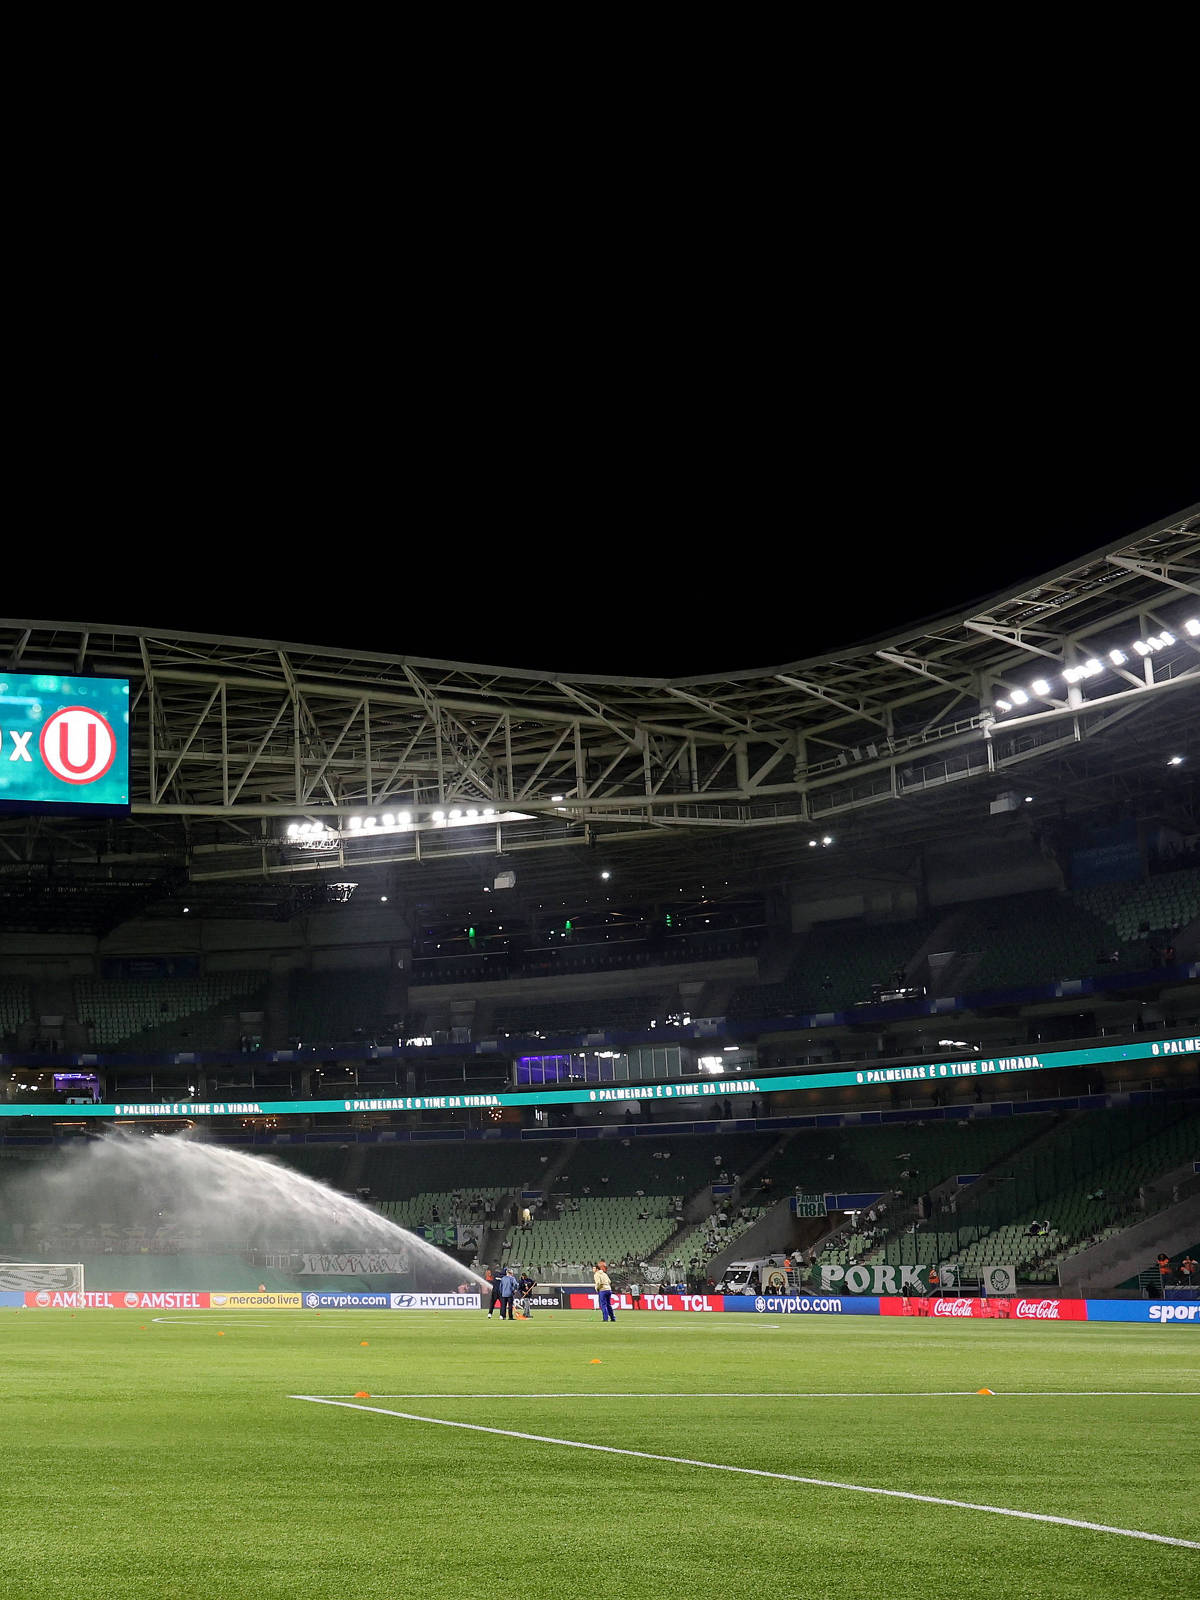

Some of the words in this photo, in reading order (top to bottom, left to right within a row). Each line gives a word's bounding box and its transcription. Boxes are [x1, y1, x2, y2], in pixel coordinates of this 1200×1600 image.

[59, 722, 97, 774] U
[1151, 1043, 1160, 1056] O
[856, 1072, 864, 1084] O
[866, 1066, 926, 1083] PALMEIRAS
[929, 1064, 936, 1077] É
[939, 1064, 947, 1077] O
[950, 1062, 978, 1076] TIME
[980, 1060, 996, 1073] DA
[589, 1090, 597, 1101] O
[599, 1087, 654, 1101] PALMEIRAS
[655, 1085, 663, 1098] É
[665, 1085, 673, 1097] O
[675, 1084, 700, 1096] TIME
[702, 1083, 716, 1095] DA
[114, 1104, 122, 1115] O
[123, 1103, 171, 1115] PALMEIRAS
[172, 1103, 179, 1114] É
[181, 1104, 189, 1115] O
[189, 1103, 211, 1114] TIME
[213, 1103, 226, 1114] DA
[344, 1100, 352, 1111] O
[353, 1098, 404, 1111] PALMEIRAS
[406, 1097, 413, 1109] É
[414, 1098, 422, 1109] O
[423, 1097, 446, 1108] TIME
[448, 1096, 461, 1107] DA
[52, 1292, 112, 1307] AMSTEL
[141, 1293, 200, 1308] AMSTEL
[228, 1294, 278, 1306] mercado
[279, 1294, 300, 1306] livre
[320, 1294, 387, 1309] crypto.com
[419, 1295, 478, 1307] HYUNDAI
[513, 1295, 560, 1307] prceless
[643, 1294, 673, 1311] TCL
[680, 1295, 713, 1312] TCL
[766, 1296, 842, 1315] crypto.com
[933, 1298, 973, 1317] Coca-Cola
[1016, 1299, 1061, 1319] Coca-Cola
[1148, 1304, 1200, 1323] spor
